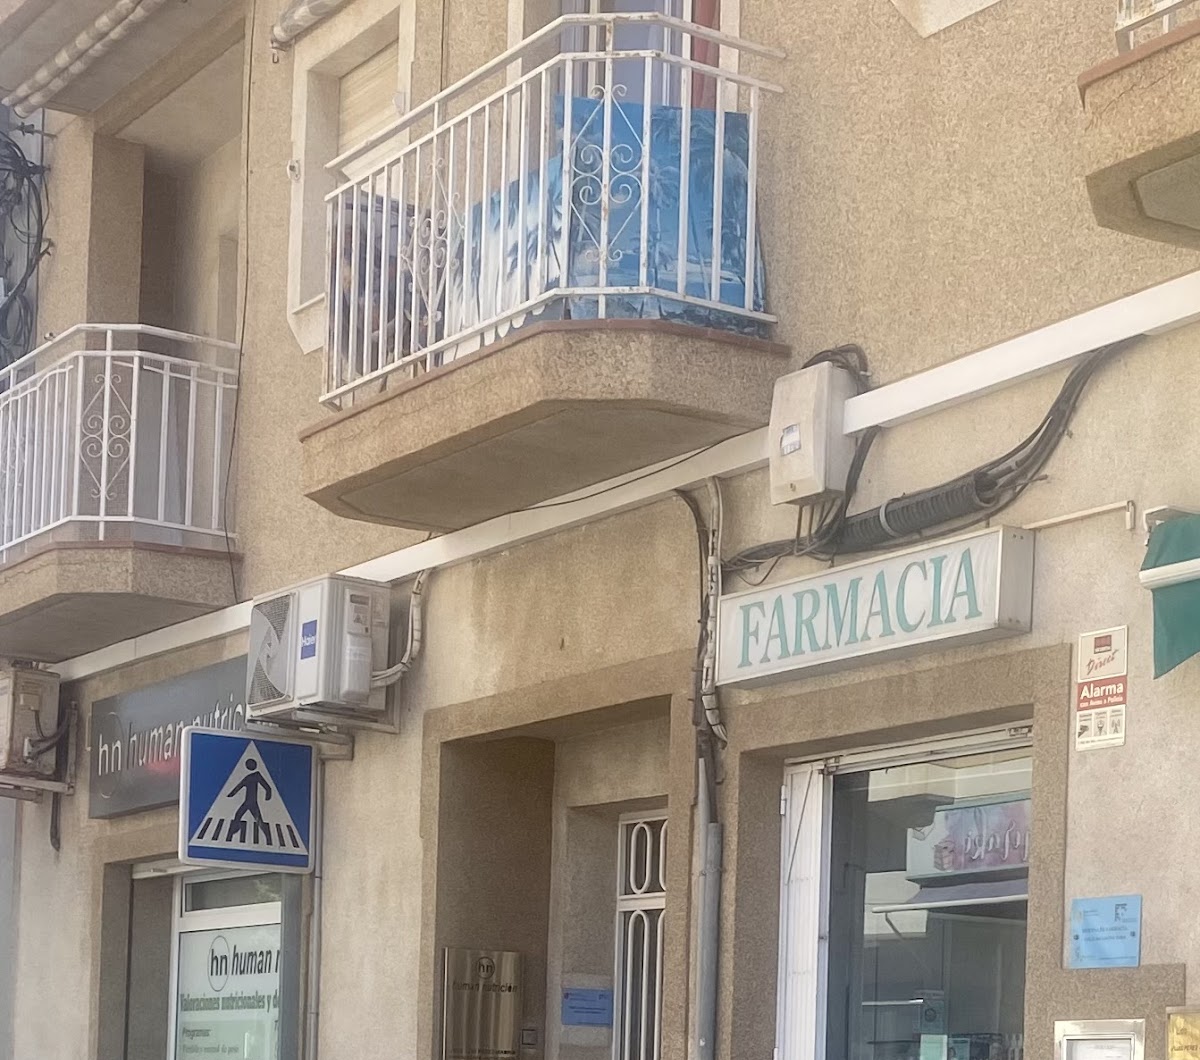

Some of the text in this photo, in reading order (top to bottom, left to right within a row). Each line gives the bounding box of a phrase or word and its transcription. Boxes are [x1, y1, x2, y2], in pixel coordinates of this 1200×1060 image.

[737, 547, 982, 669] FARMACIA
[1080, 682, 1124, 701] Alarma
[98, 733, 121, 776] hn
[127, 720, 184, 769] human
[210, 948, 228, 976] hn
[231, 944, 272, 976] human
[478, 962, 493, 974] hn
